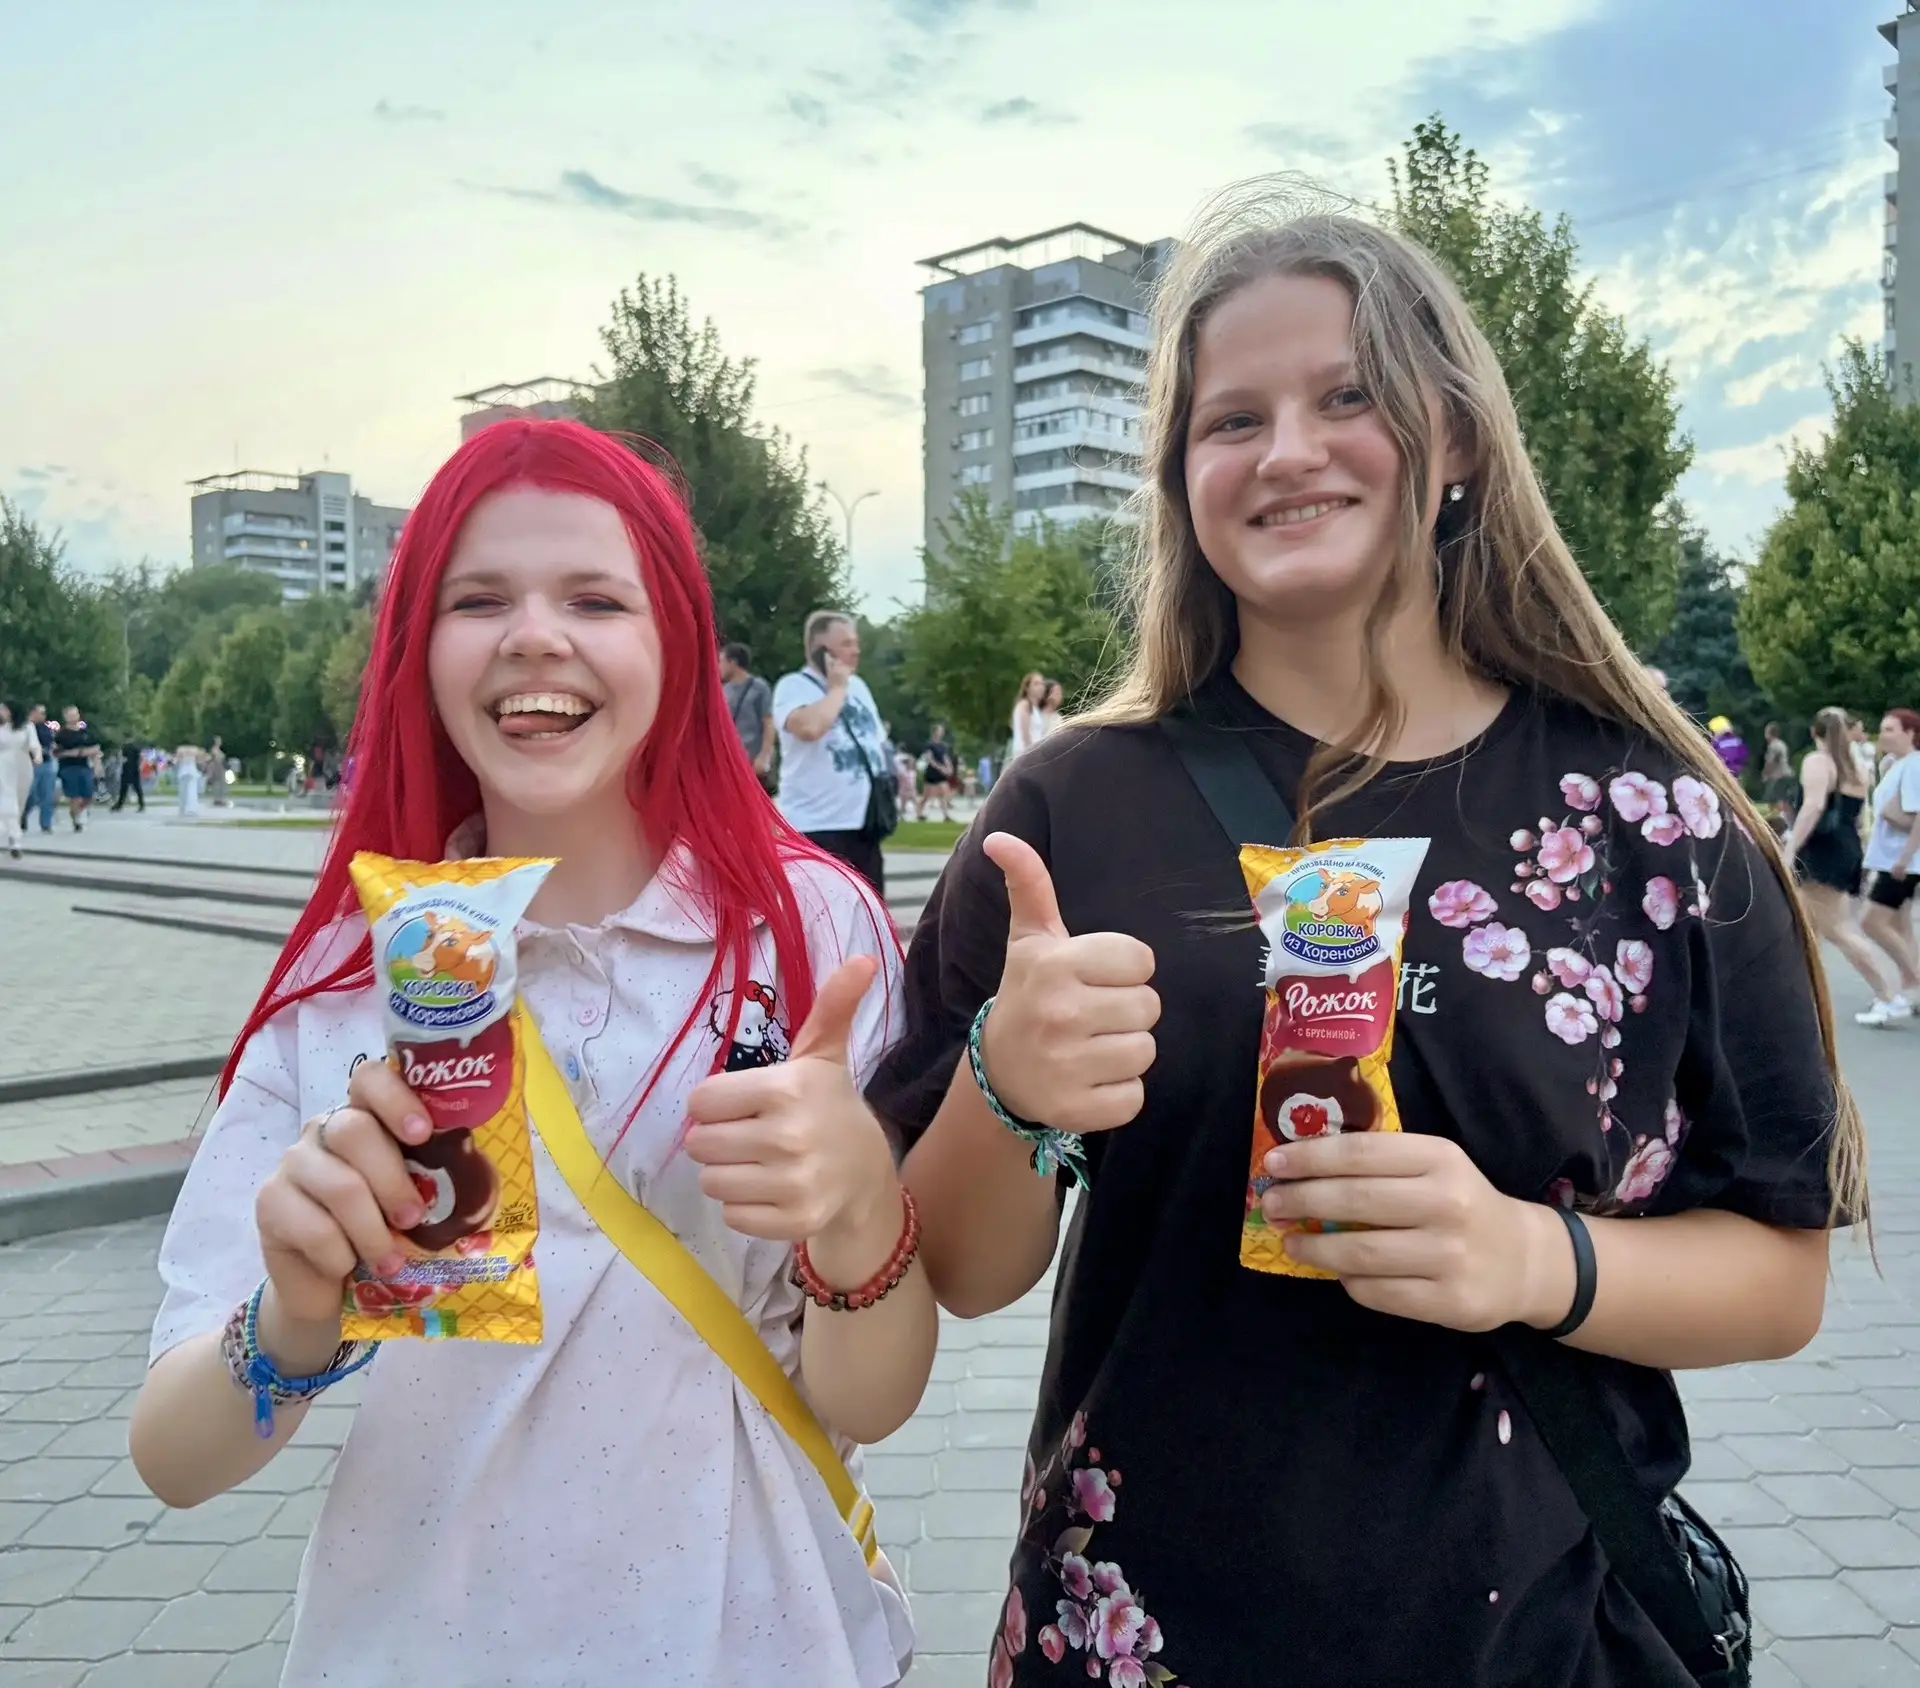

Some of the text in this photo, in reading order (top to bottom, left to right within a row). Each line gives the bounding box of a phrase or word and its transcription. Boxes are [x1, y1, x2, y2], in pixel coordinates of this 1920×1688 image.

[1291, 859, 1384, 878] ПРОИЗВЕДЕНО НА КУБАНИ
[1298, 922, 1365, 938] КОРОВКА
[1285, 981, 1378, 1023] Рожок
[1305, 1027, 1356, 1040] БРУСНИКОЙ
